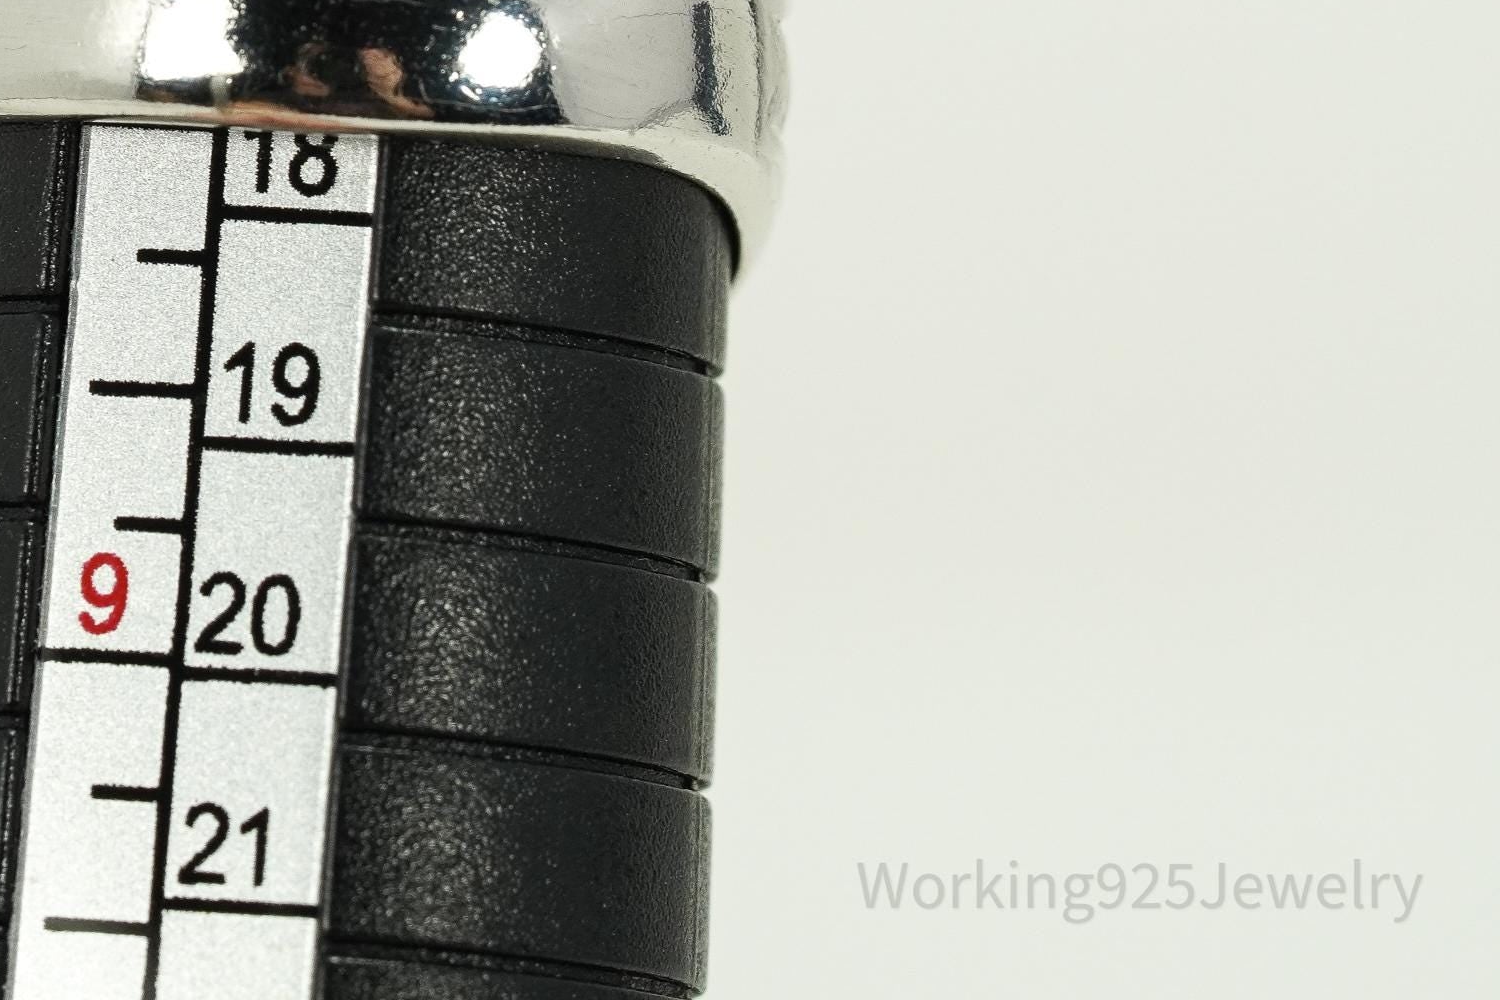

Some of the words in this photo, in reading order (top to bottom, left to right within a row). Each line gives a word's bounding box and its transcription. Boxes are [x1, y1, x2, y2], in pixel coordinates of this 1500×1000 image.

[243, 131, 339, 197] 18
[223, 341, 321, 427] 19
[78, 552, 129, 635] 9
[194, 571, 302, 656] 20
[177, 802, 270, 887] 21
